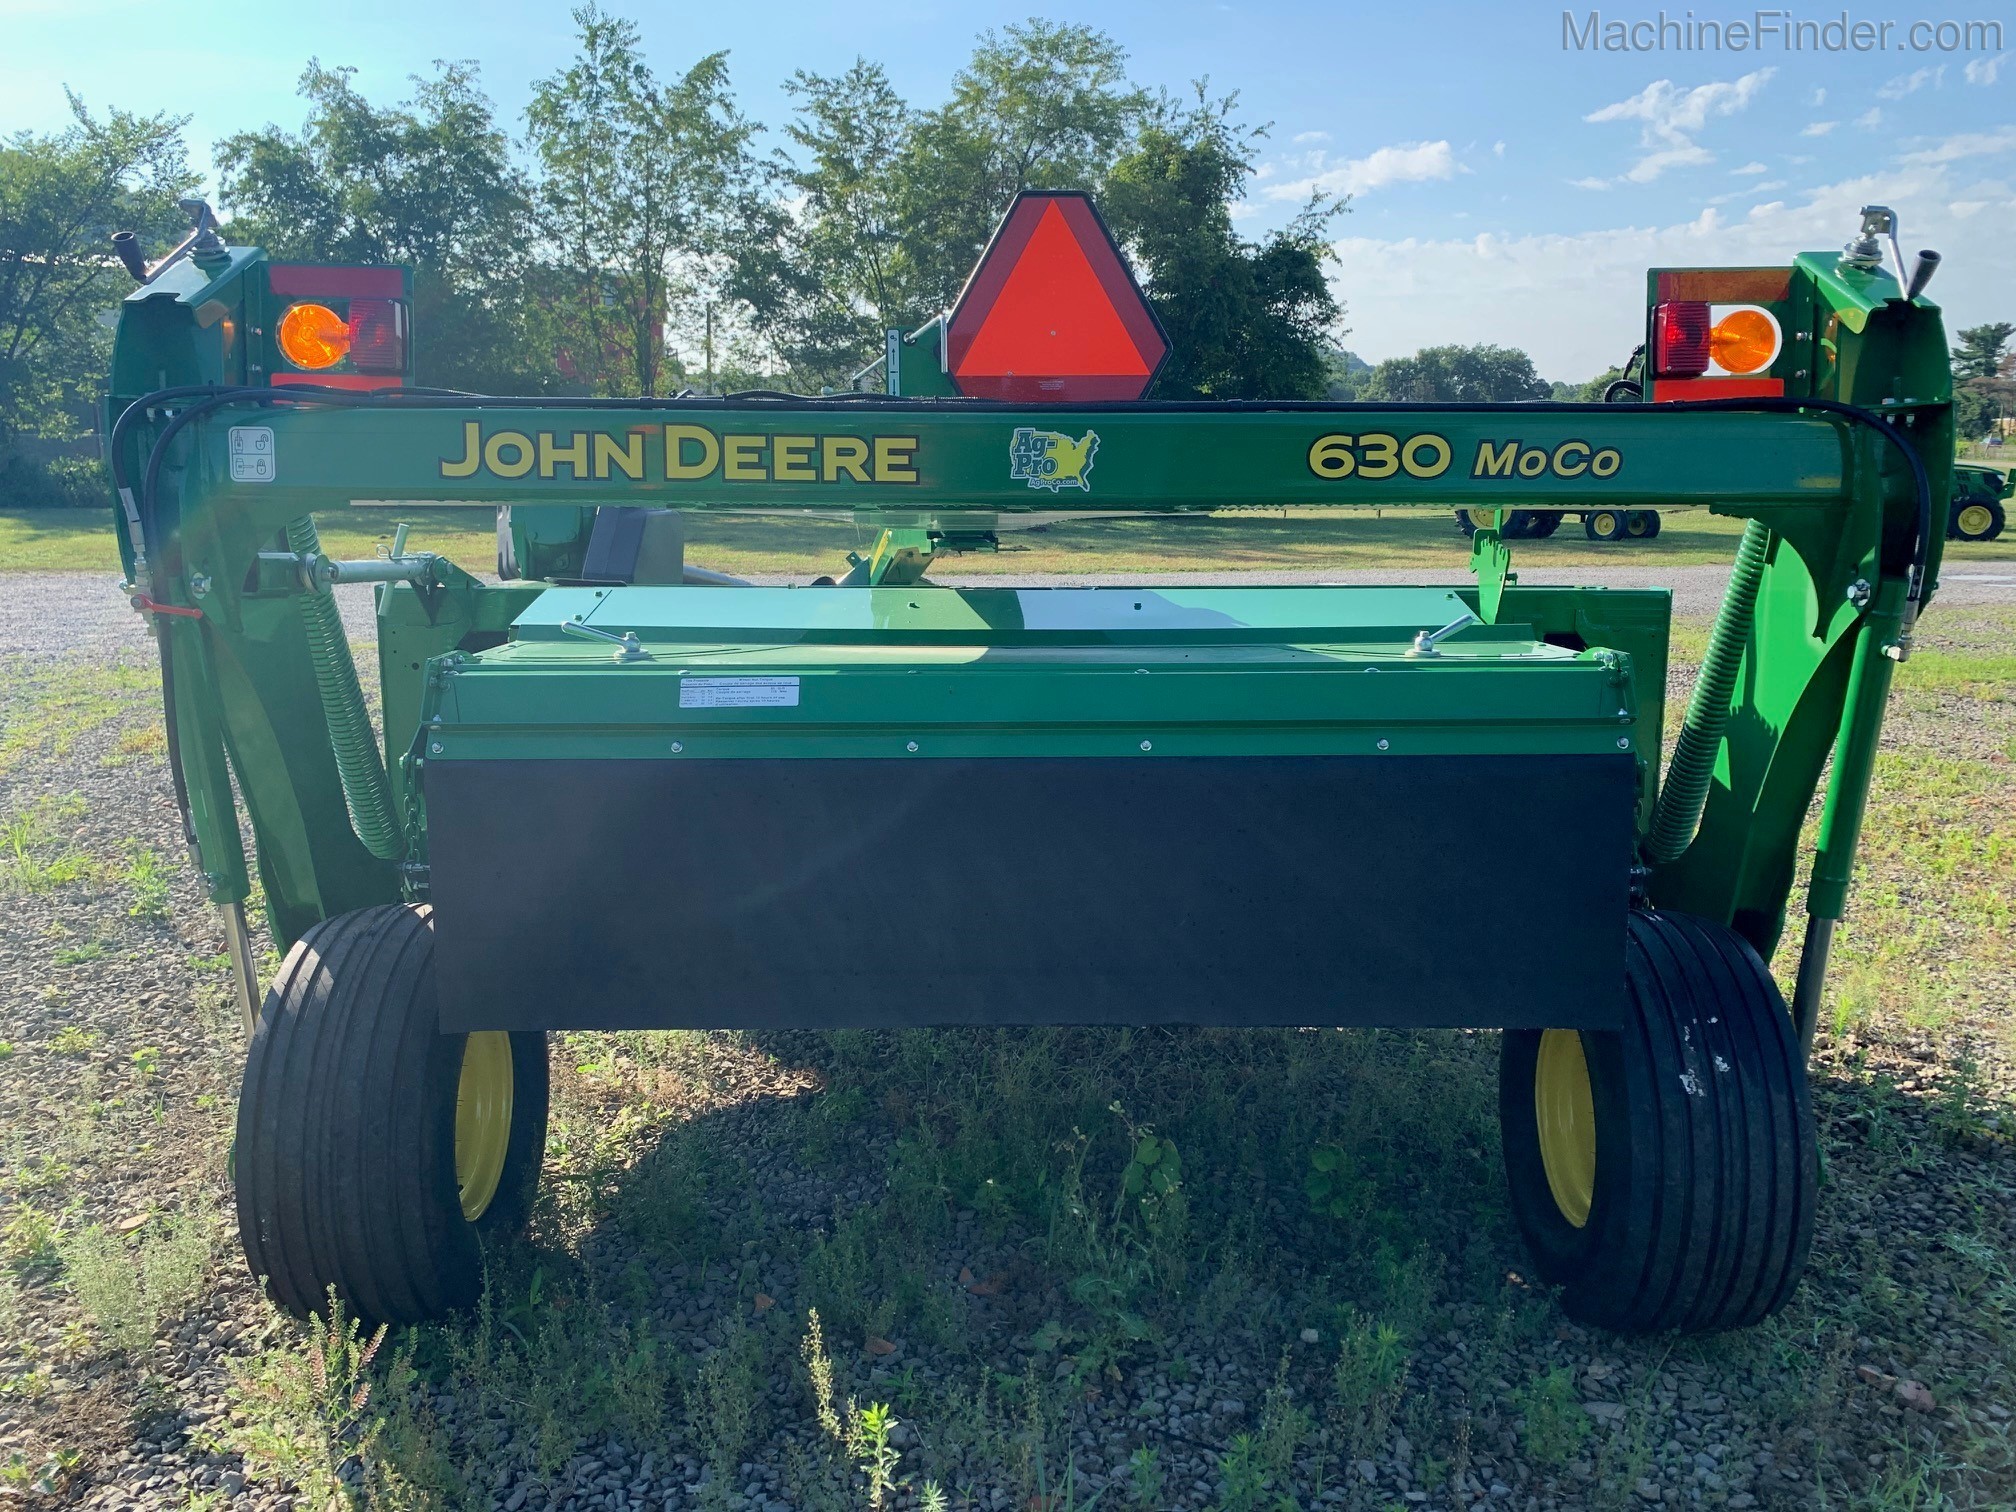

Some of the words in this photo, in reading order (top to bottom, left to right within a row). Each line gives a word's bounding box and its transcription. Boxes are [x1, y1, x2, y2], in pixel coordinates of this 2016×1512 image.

[439, 420, 646, 481] JOHN
[662, 420, 919, 485] DEERE
[1013, 454, 1058, 477] Pro
[1307, 432, 1452, 480] 630
[1470, 439, 1624, 479] MoCo
[1031, 479, 1078, 487] AgProCo.com
